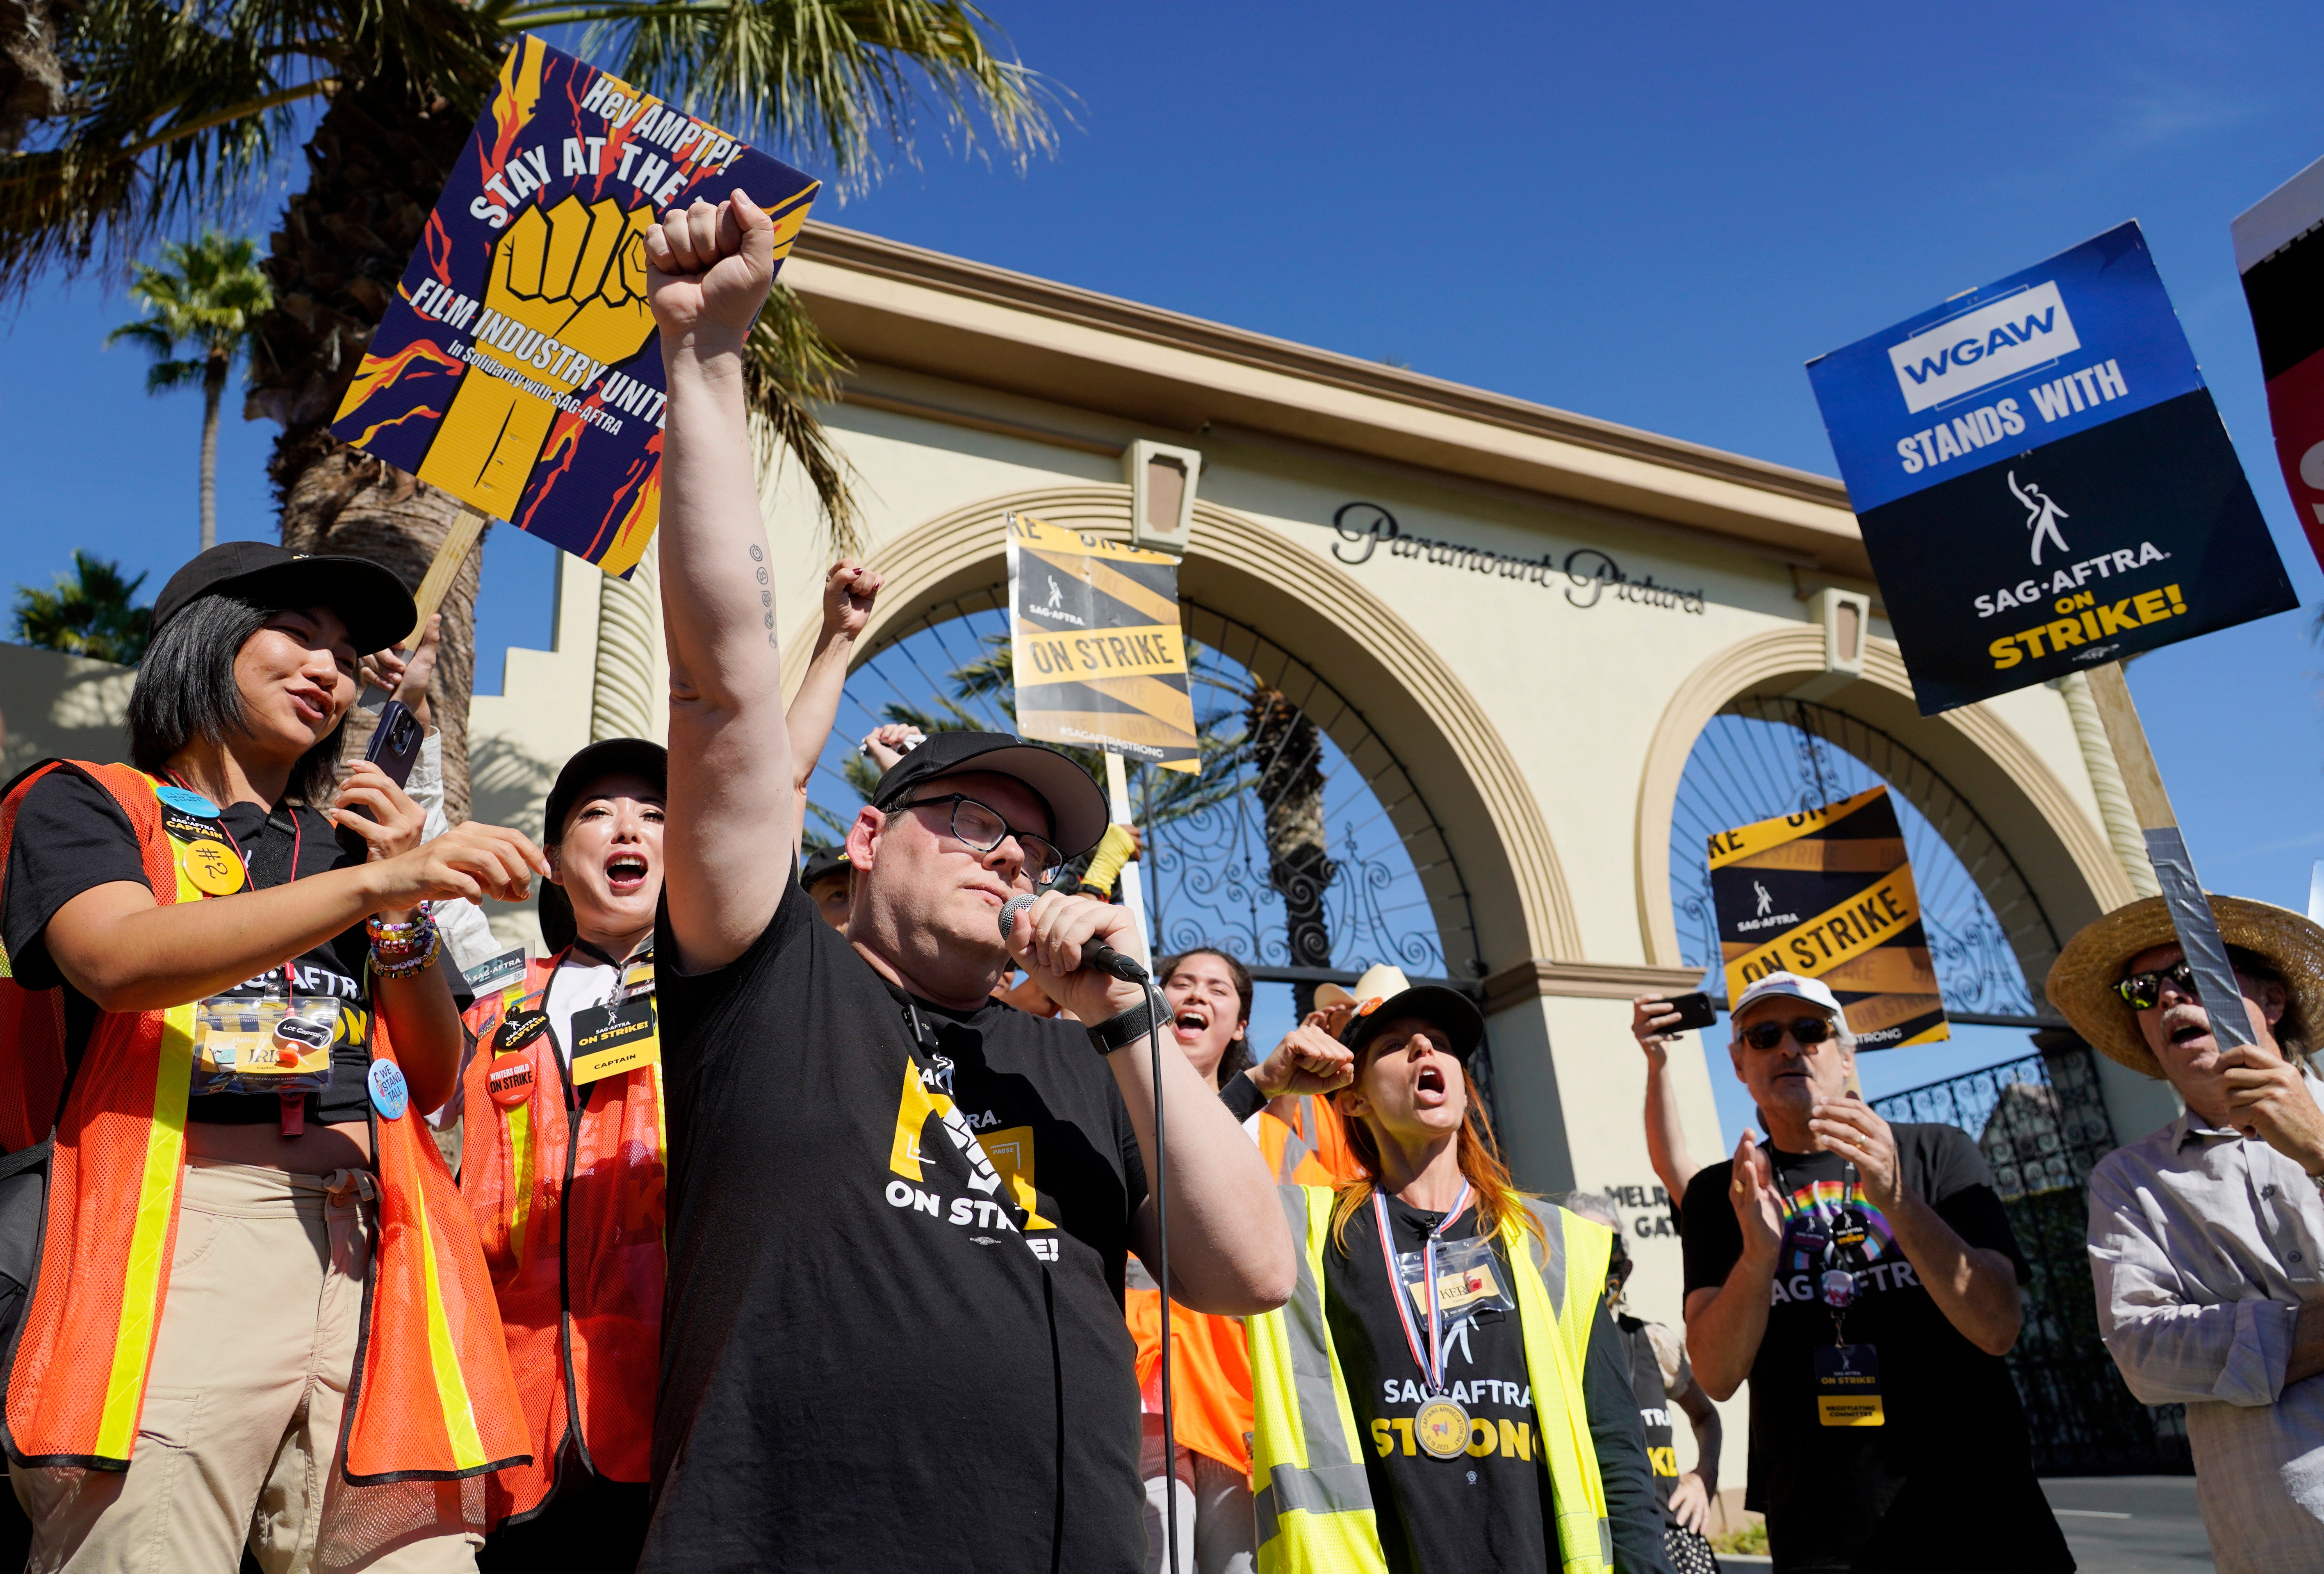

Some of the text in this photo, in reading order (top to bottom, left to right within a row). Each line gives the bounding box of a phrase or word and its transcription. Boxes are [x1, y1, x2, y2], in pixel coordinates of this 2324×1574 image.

[581, 77, 742, 176] Hey AMPTP!
[470, 136, 688, 228] STAY AT THE
[409, 277, 480, 330] FILM
[470, 307, 608, 392] INDUSTRY
[1903, 305, 2054, 385] WGAW
[447, 339, 623, 436] In Solidarity with SAG-AFTRA
[1897, 359, 2128, 474] STANDS WITH
[1332, 502, 1704, 615] Paramount Pictures
[2054, 590, 2095, 614] ON
[1989, 583, 2187, 669] STRIKE!
[1030, 634, 1174, 674] ON STRIKE
[1060, 726, 1164, 758] #SAGAFTRASTRONG
[166, 820, 223, 840] CAPTAIN
[1790, 886, 1908, 969] STRIKE
[296, 1028, 325, 1041] Captain!
[506, 1016, 547, 1047] CAPTAIN
[579, 1020, 648, 1046] ON STRIKE!
[379, 1065, 392, 1078] WE
[490, 1063, 529, 1081] WRITERS GUILD
[594, 1054, 636, 1069] CAPTAIN
[382, 1072, 402, 1091] STAND
[388, 1086, 402, 1101] TALL
[490, 1071, 533, 1093] ON STRIKE
[885, 1180, 940, 1217] ON
[1604, 1186, 1669, 1207] MELR
[1422, 1407, 1464, 1446] CAPTAINS APPRECIATION DAY
